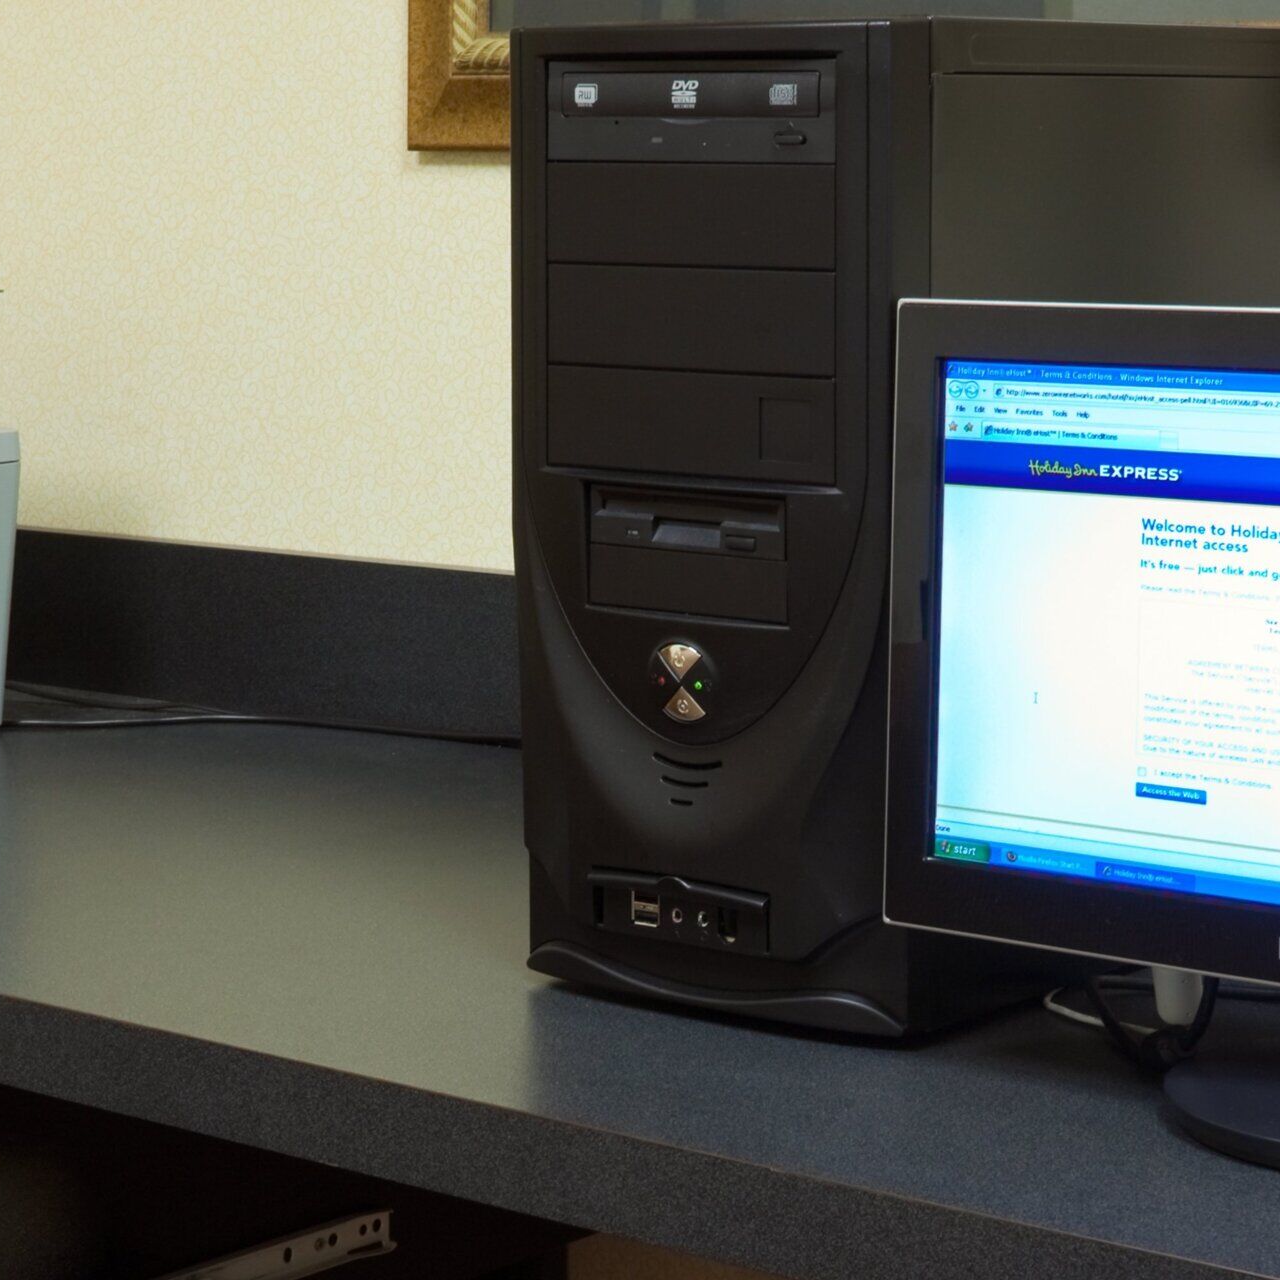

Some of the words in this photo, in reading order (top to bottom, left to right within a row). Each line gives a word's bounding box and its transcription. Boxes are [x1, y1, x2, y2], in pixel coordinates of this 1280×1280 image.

[671, 80, 699, 90] DVD
[1040, 370, 1064, 380] Terms
[1072, 371, 1113, 382] Conditions
[1120, 372, 1155, 384] Windows
[1157, 374, 1189, 385] Internet
[1190, 376, 1223, 388] Explorer
[1015, 407, 1044, 417] Favorites
[1052, 409, 1068, 418] Tools
[1076, 410, 1091, 420] Help
[1028, 459, 1072, 479] Holiday
[1099, 464, 1180, 482] EXPRESS
[1141, 517, 1206, 537] Welcome
[1210, 524, 1226, 537] to
[1141, 533, 1199, 550] Internet
[1202, 539, 1249, 554] access
[1140, 558, 1156, 571] It's
[1158, 560, 1180, 572] free
[1197, 563, 1218, 577] just
[1221, 564, 1245, 577] click
[1248, 568, 1268, 579] and
[1142, 786, 1167, 796] Access
[1183, 791, 1200, 800] Web
[953, 844, 976, 856] start
